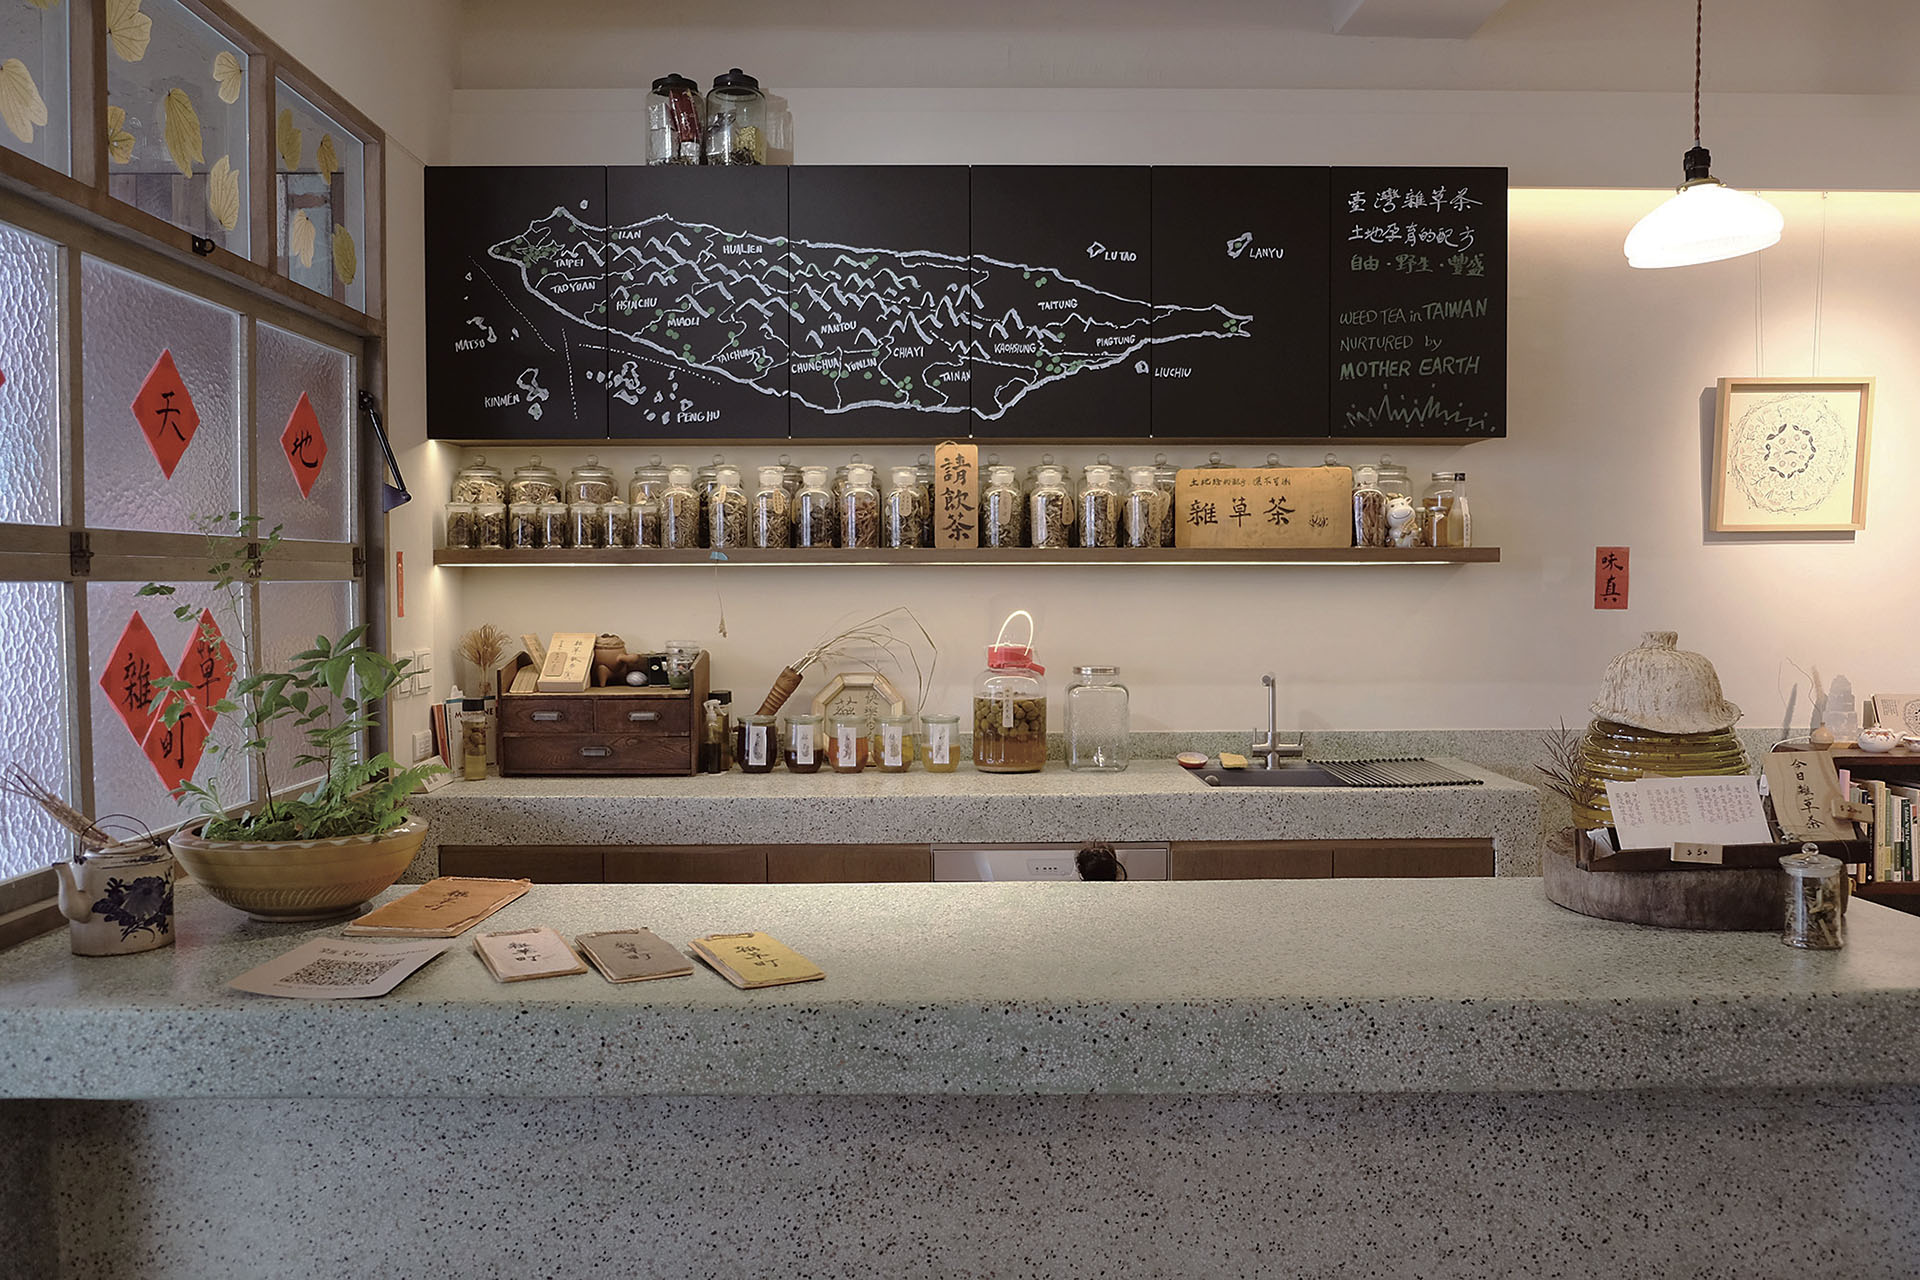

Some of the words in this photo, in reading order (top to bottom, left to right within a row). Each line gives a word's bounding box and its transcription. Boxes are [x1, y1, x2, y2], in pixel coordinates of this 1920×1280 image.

[618, 230, 642, 240] ILAN
[1348, 222, 1475, 252] 土地孕育的配方
[723, 244, 763, 255] HUALIEN
[1250, 248, 1284, 259] LANYU
[553, 259, 584, 269] TAIPEI
[616, 298, 658, 310] HSINCHU
[1038, 299, 1078, 311] TAITUNG
[1340, 309, 1378, 326] WEED
[1380, 307, 1407, 325] TEA
[1409, 310, 1422, 322] in
[1422, 298, 1488, 320] TAIWAN
[667, 317, 700, 328] MIAOLI
[821, 320, 857, 334] NANTOU
[455, 338, 486, 352] MATSU
[994, 343, 1036, 354] KAOHSIUNG
[1340, 335, 1414, 351] NURTURED
[1425, 335, 1442, 351] by
[893, 347, 924, 358] CHIAYI
[791, 358, 839, 374] CHUNGHUA
[844, 357, 877, 373] YUNLIN
[1340, 360, 1411, 381] MOTHER
[1419, 356, 1480, 375] EARTH
[939, 370, 971, 383] TAINAN
[1155, 367, 1192, 379] LIUCHIU
[484, 394, 520, 408] KINMEN
[156, 391, 186, 441] 天
[291, 430, 319, 468] 地
[940, 453, 975, 541] 請飲茶
[1187, 496, 1296, 528] 雜草茶
